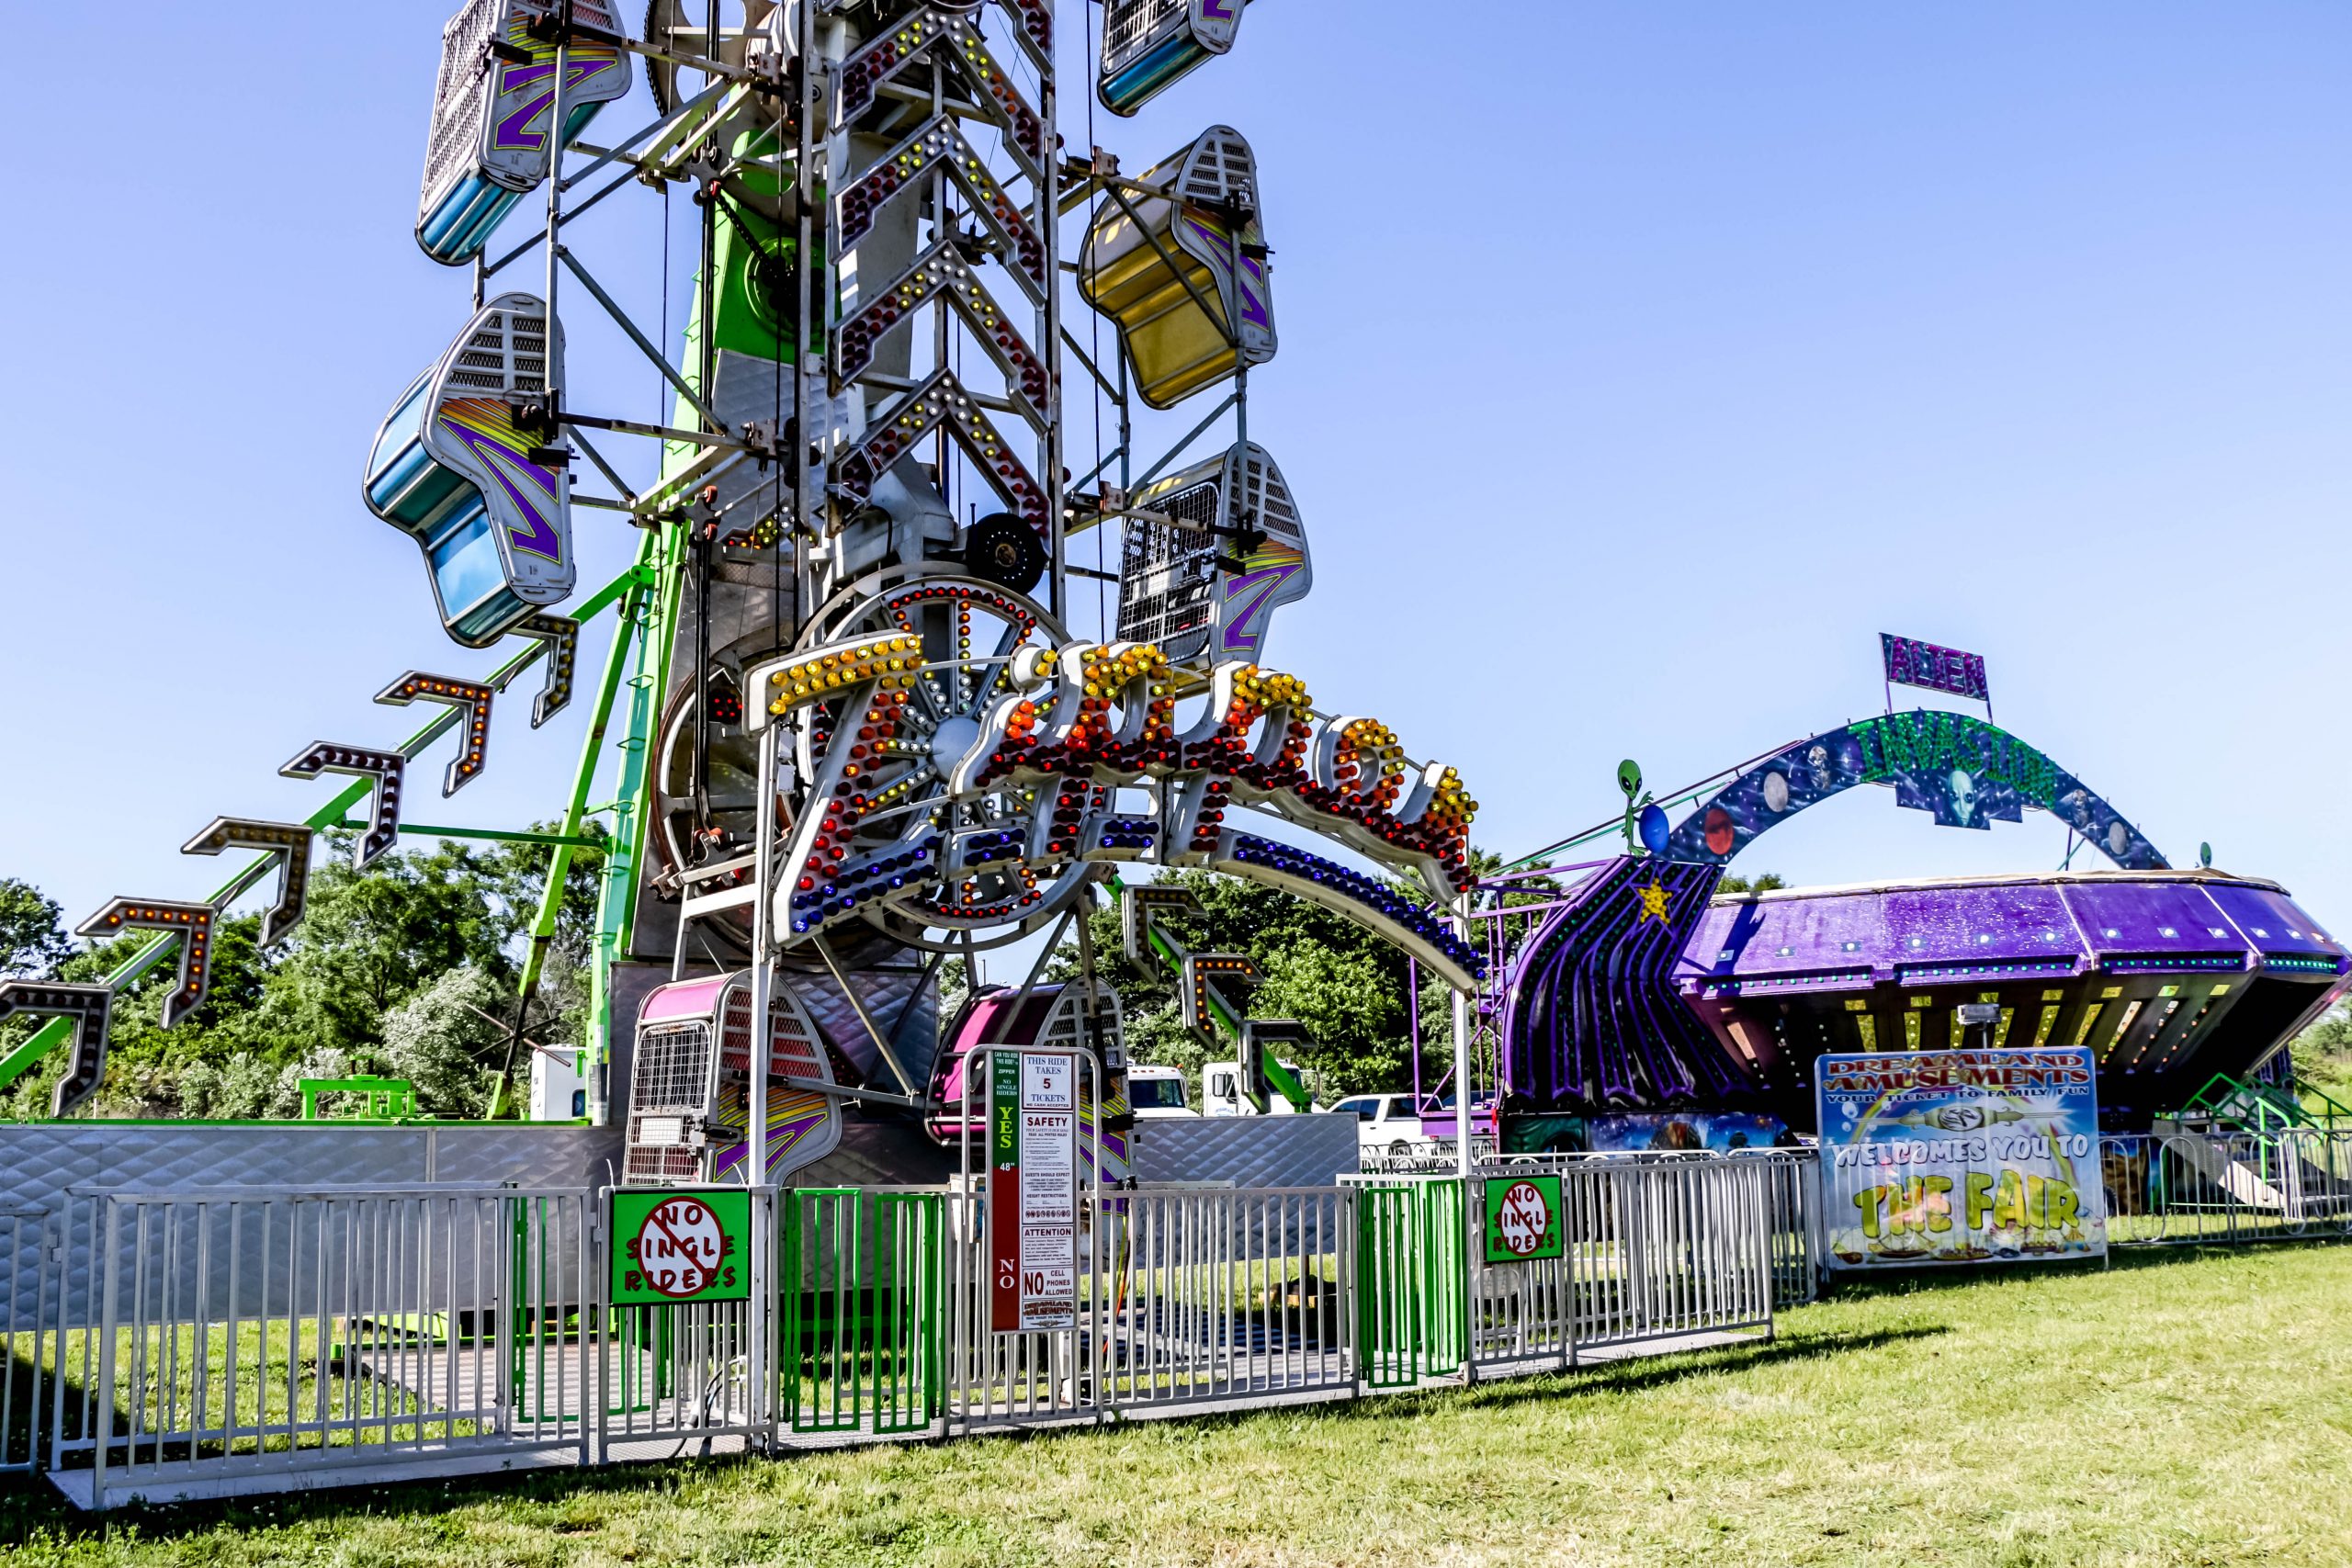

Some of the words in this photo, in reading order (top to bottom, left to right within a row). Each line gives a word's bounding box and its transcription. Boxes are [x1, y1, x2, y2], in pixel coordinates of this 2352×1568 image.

[1888, 635, 1987, 700] ALIEN
[1847, 712, 2056, 809] INVASION
[1027, 1057, 1046, 1066] THIS
[1035, 1066, 1062, 1075] TAKES
[1828, 1053, 2085, 1075] DREAMLAND
[1043, 1077, 1051, 1089] 5
[1823, 1067, 2090, 1091] AMUSEMENTS
[1031, 1094, 1066, 1102] TICKETS
[1827, 1094, 1876, 1103] YOUR
[1884, 1091, 1949, 1102] TICKET
[1987, 1089, 2049, 1097] FAMILY
[2057, 1087, 2089, 1095] FUN
[999, 1106, 1013, 1148] YES
[1027, 1116, 1068, 1127] SAFETY
[1831, 1138, 1988, 1167] WELCOMES
[1991, 1135, 2053, 1161] YOU
[2055, 1134, 2088, 1158] TO
[1000, 1162, 1015, 1171] 48"
[1511, 1187, 1535, 1203] NO
[1853, 1176, 1953, 1238] THE
[1965, 1169, 2080, 1230] FAIR
[661, 1204, 703, 1226] NO
[1493, 1210, 1554, 1228] SINGLE
[1024, 1228, 1071, 1236] ATTENTION
[1493, 1233, 1555, 1252] RIDERS
[626, 1235, 735, 1259] SINGLE
[625, 1266, 736, 1291] RIDERS
[1000, 1258, 1015, 1289] NO
[1024, 1271, 1044, 1296] NO
